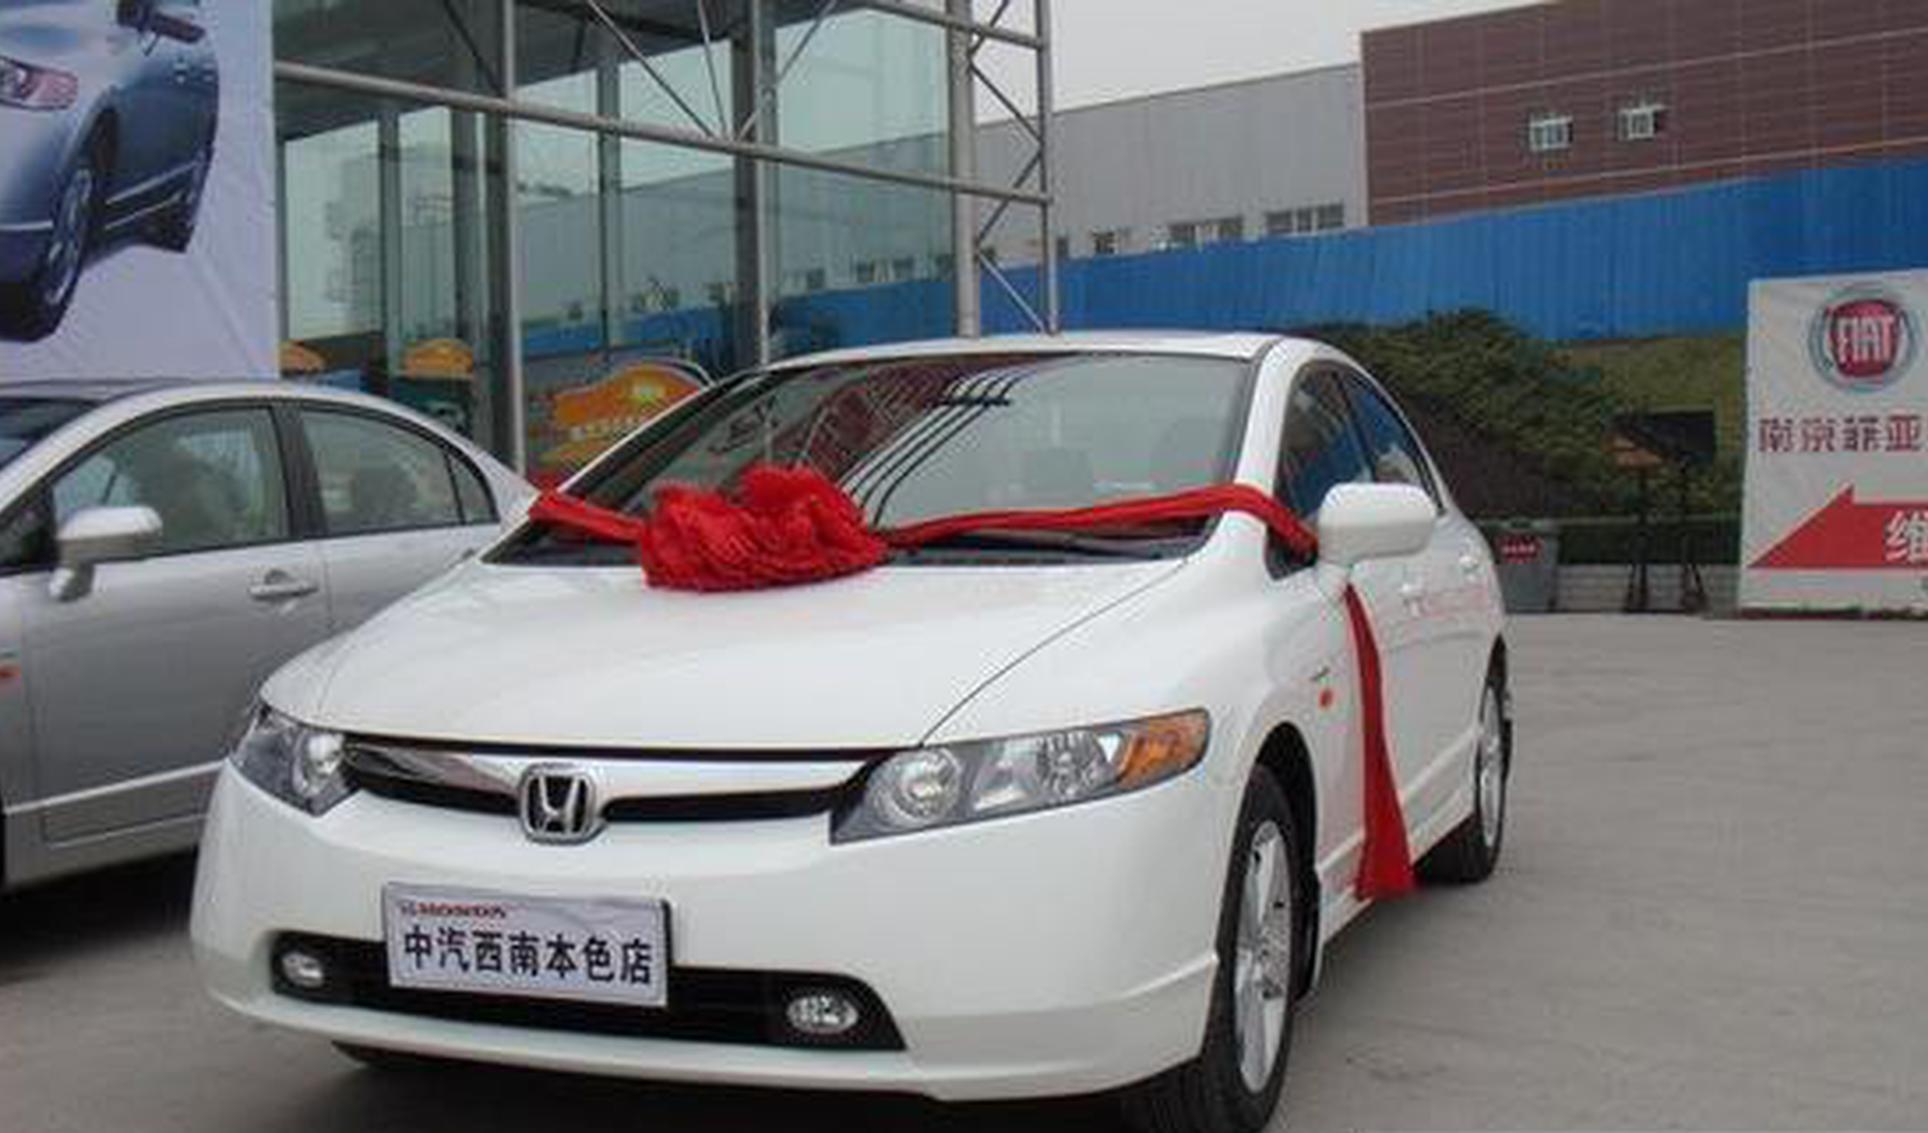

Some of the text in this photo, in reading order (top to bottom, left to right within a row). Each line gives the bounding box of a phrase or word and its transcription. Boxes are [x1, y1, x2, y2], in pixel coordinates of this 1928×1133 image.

[1837, 315, 1895, 363] FIAT
[403, 924, 653, 985] 中汽西南本色店
